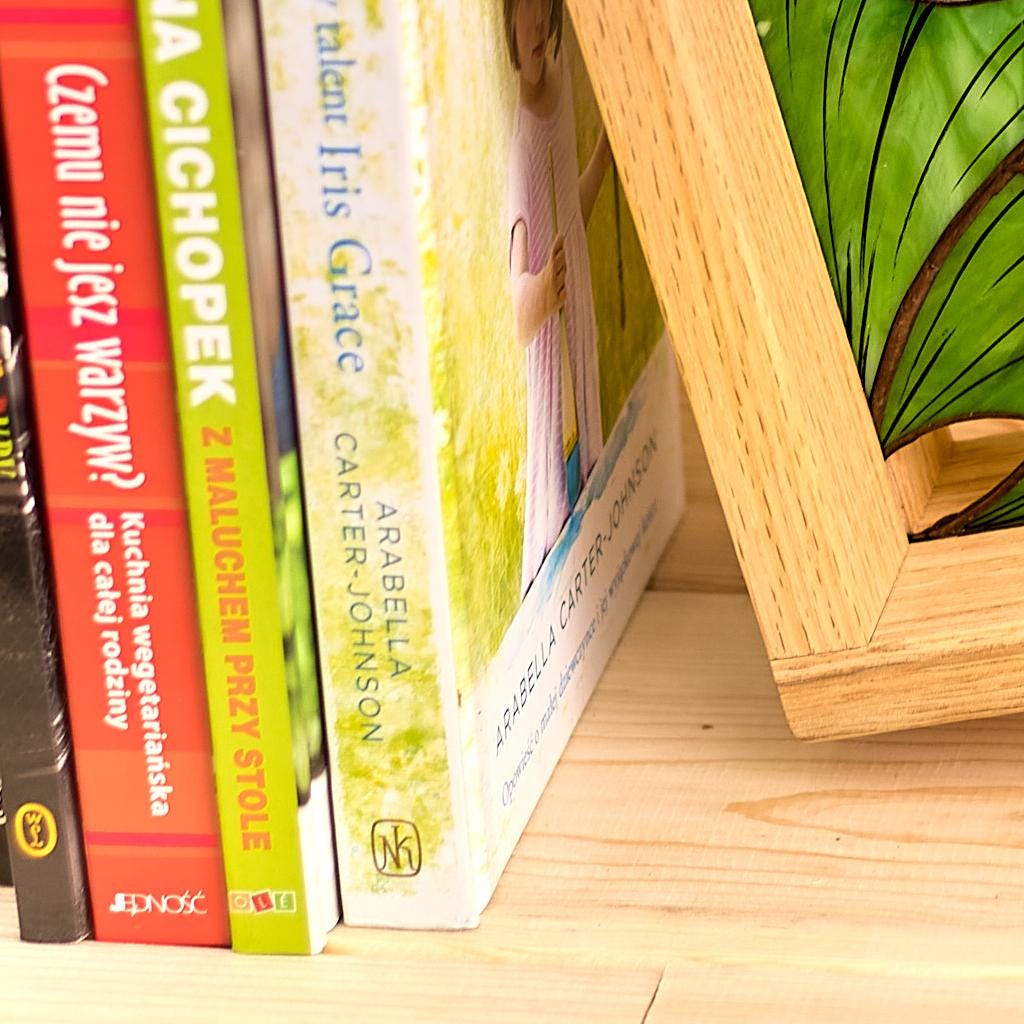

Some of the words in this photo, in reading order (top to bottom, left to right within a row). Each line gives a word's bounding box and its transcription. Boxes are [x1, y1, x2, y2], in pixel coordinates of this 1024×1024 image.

[45, 64, 109, 182] Czemu
[315, 21, 357, 124] talent
[57, 196, 121, 250] nie
[319, 145, 361, 218] Iris
[53, 258, 125, 327] jesz
[159, 79, 237, 407] CICHOPEK
[329, 238, 373, 373] Grace
[67, 337, 146, 490] warzyw?
[201, 426, 232, 447] Z
[88, 513, 115, 556] dla
[120, 512, 153, 619] Kuchnia
[204, 458, 251, 644] MALUCHEM
[334, 432, 383, 742] CARTER-JOHNSON
[92, 560, 124, 624] całej
[376, 500, 412, 677] ARABELLA
[496, 625, 556, 757] ARABELLA
[560, 433, 657, 629] CARTER-JOHNSON
[101, 629, 131, 730] rodziny
[131, 624, 173, 817] wegetariańska
[225, 654, 260, 740] PRZY
[233, 748, 271, 851] STOLE
